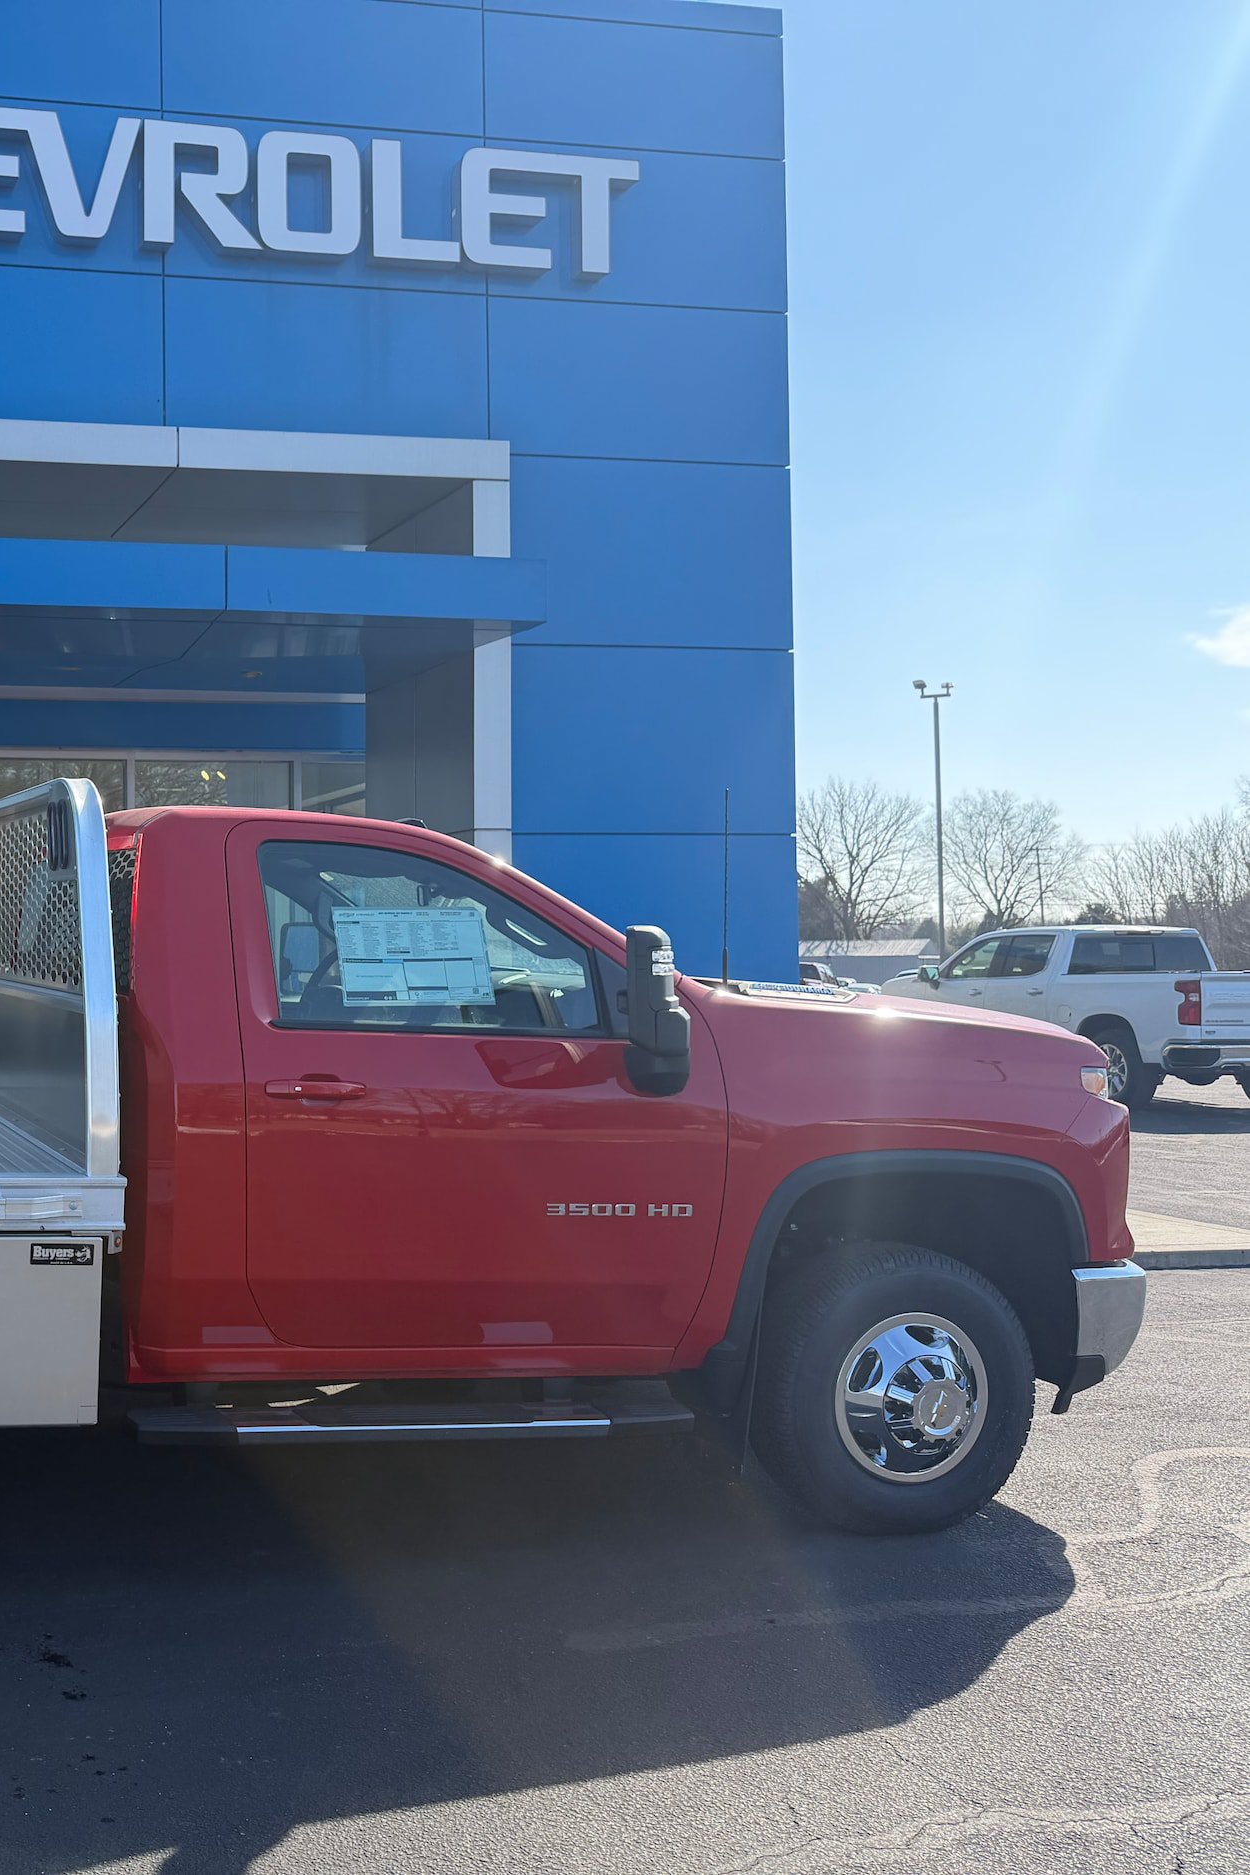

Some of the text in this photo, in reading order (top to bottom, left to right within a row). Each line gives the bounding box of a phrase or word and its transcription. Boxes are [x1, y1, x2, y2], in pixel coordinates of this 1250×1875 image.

[546, 1203, 694, 1216] 3500 HD
[33, 1245, 75, 1260] Buyers
